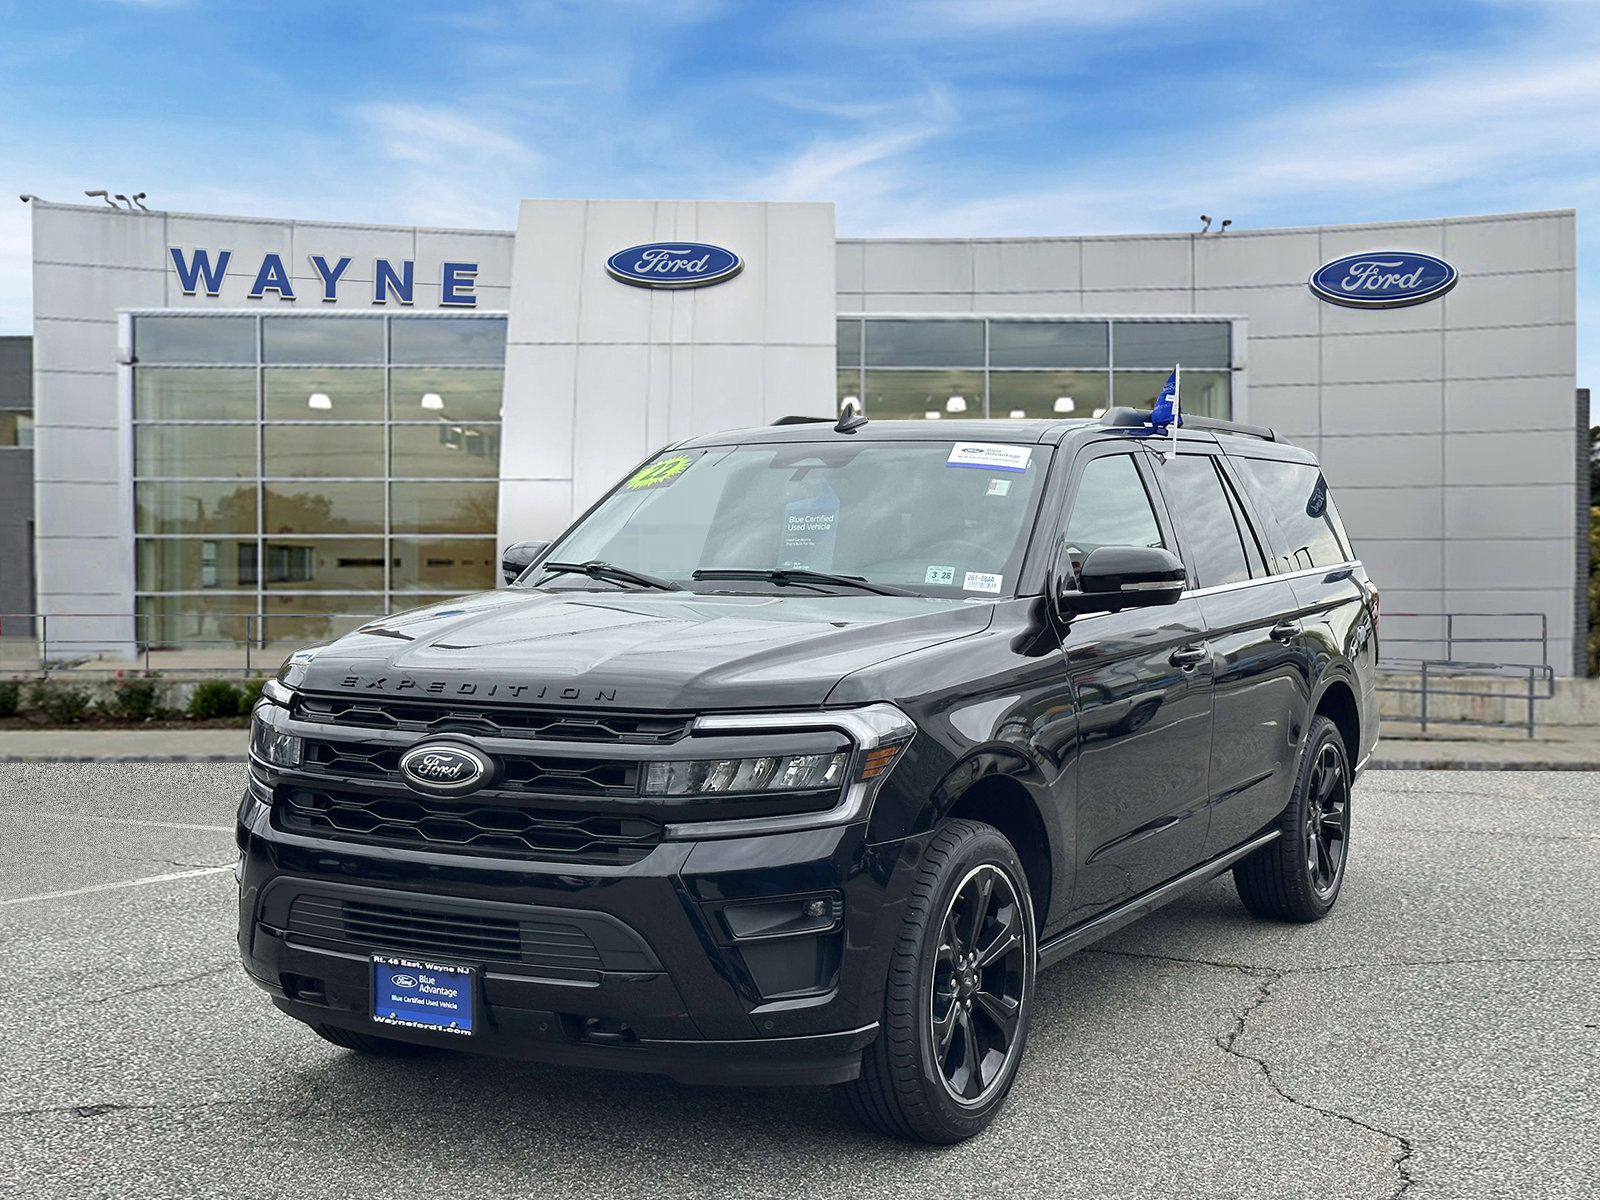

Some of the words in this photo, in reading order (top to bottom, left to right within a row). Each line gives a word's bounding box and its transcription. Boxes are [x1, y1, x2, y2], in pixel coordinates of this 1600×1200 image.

[633, 248, 711, 274] Ford
[169, 247, 480, 306] WAYNE
[1341, 261, 1425, 292] Ford
[787, 523, 806, 531] Used
[806, 523, 831, 531] Vehicle
[805, 514, 834, 523] Certified
[931, 571, 938, 579] 3
[941, 571, 952, 580] 28
[340, 675, 617, 701] EXPEDITION
[418, 753, 463, 779] Ford
[373, 955, 386, 963] Rt.
[388, 958, 399, 966] 46
[400, 960, 423, 970] East,
[425, 962, 455, 973] Wayne
[457, 966, 470, 975] NJ
[396, 975, 413, 987] Ford
[418, 974, 436, 985] Blue
[418, 984, 458, 998] Advantage
[391, 994, 403, 1002] Blue
[403, 996, 425, 1006] Certified
[425, 999, 439, 1007] Used
[439, 1001, 458, 1010] Vehicle
[373, 1015, 472, 1036] Wayneford1.com
